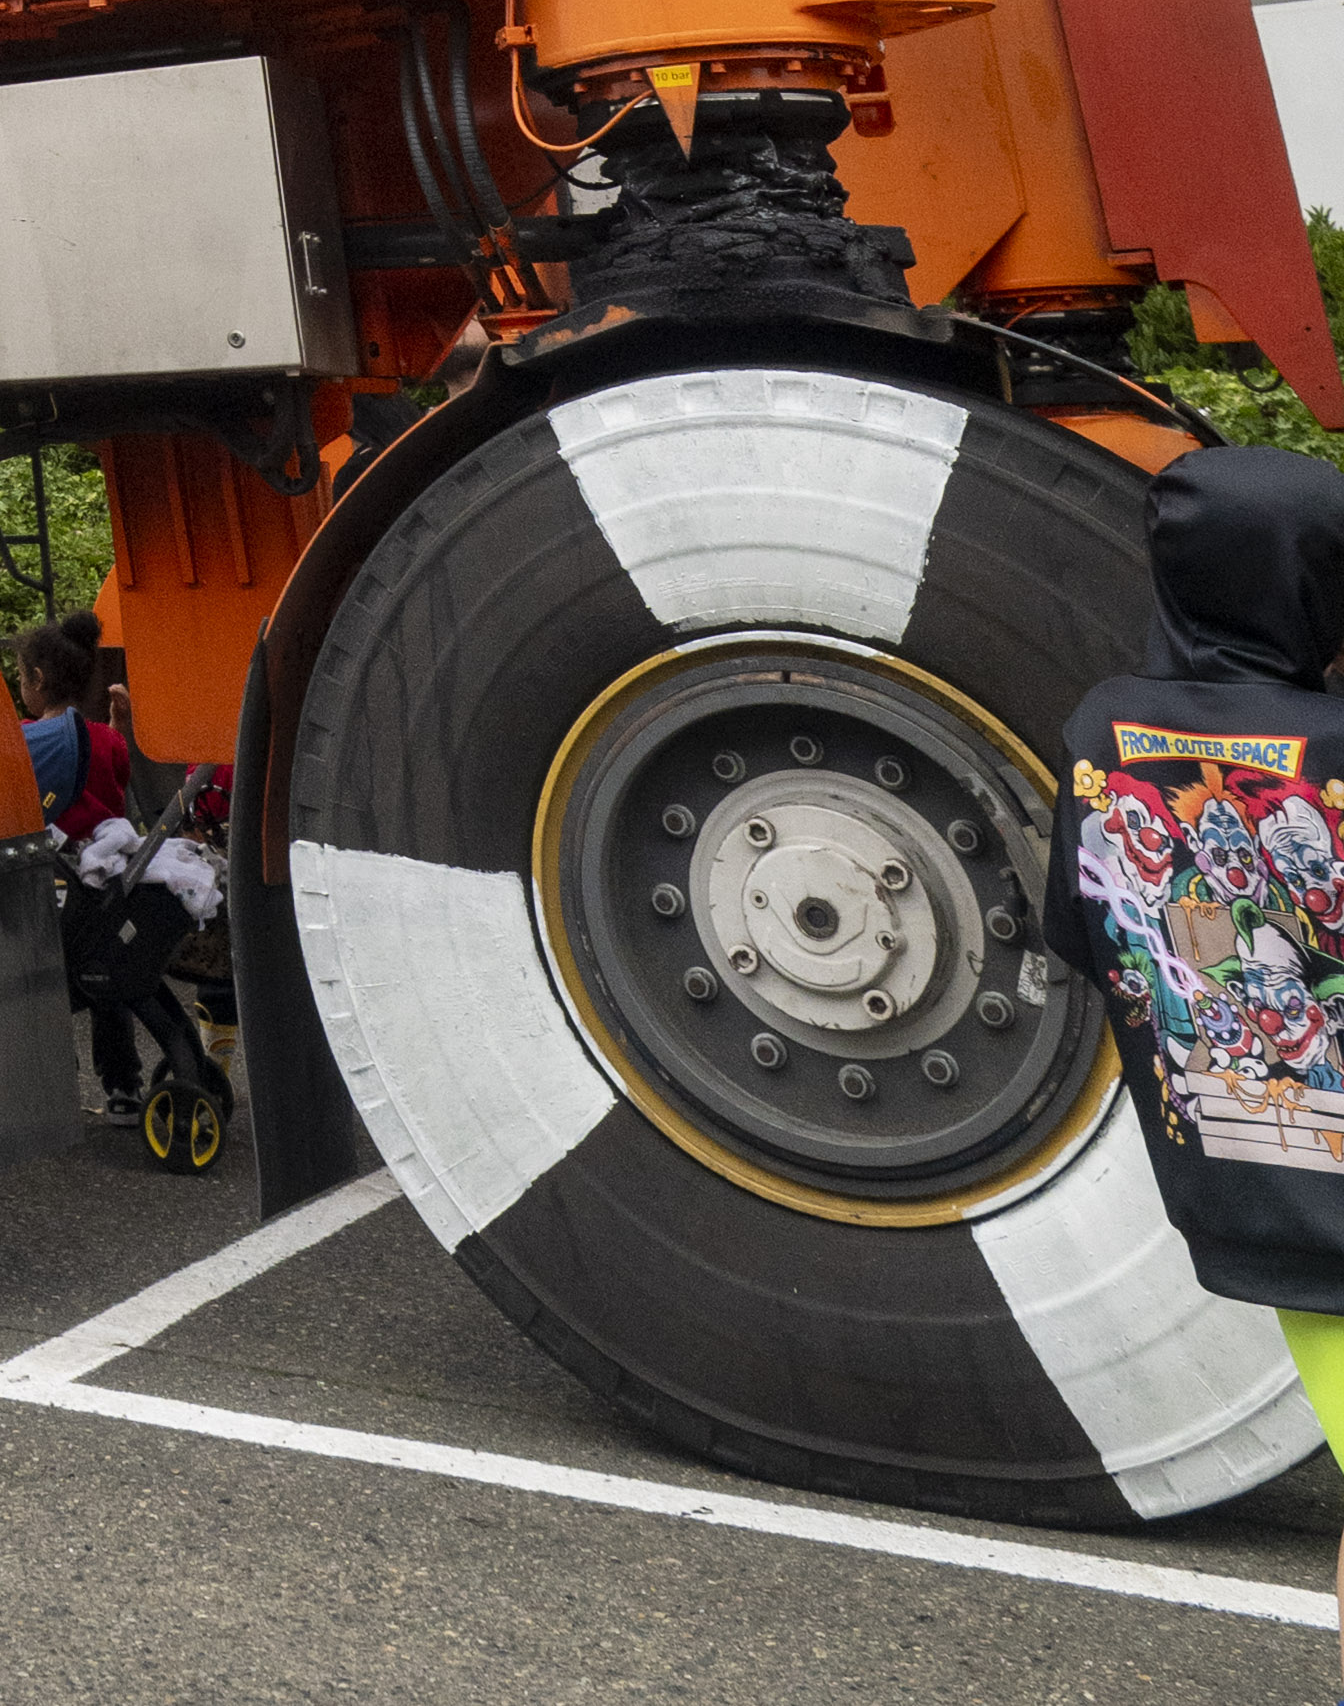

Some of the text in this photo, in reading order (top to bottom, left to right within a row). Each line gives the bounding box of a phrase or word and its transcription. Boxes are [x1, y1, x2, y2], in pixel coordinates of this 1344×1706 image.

[656, 71, 689, 81] 10 bar
[1120, 730, 1291, 772] FROM OUTER SPACE
